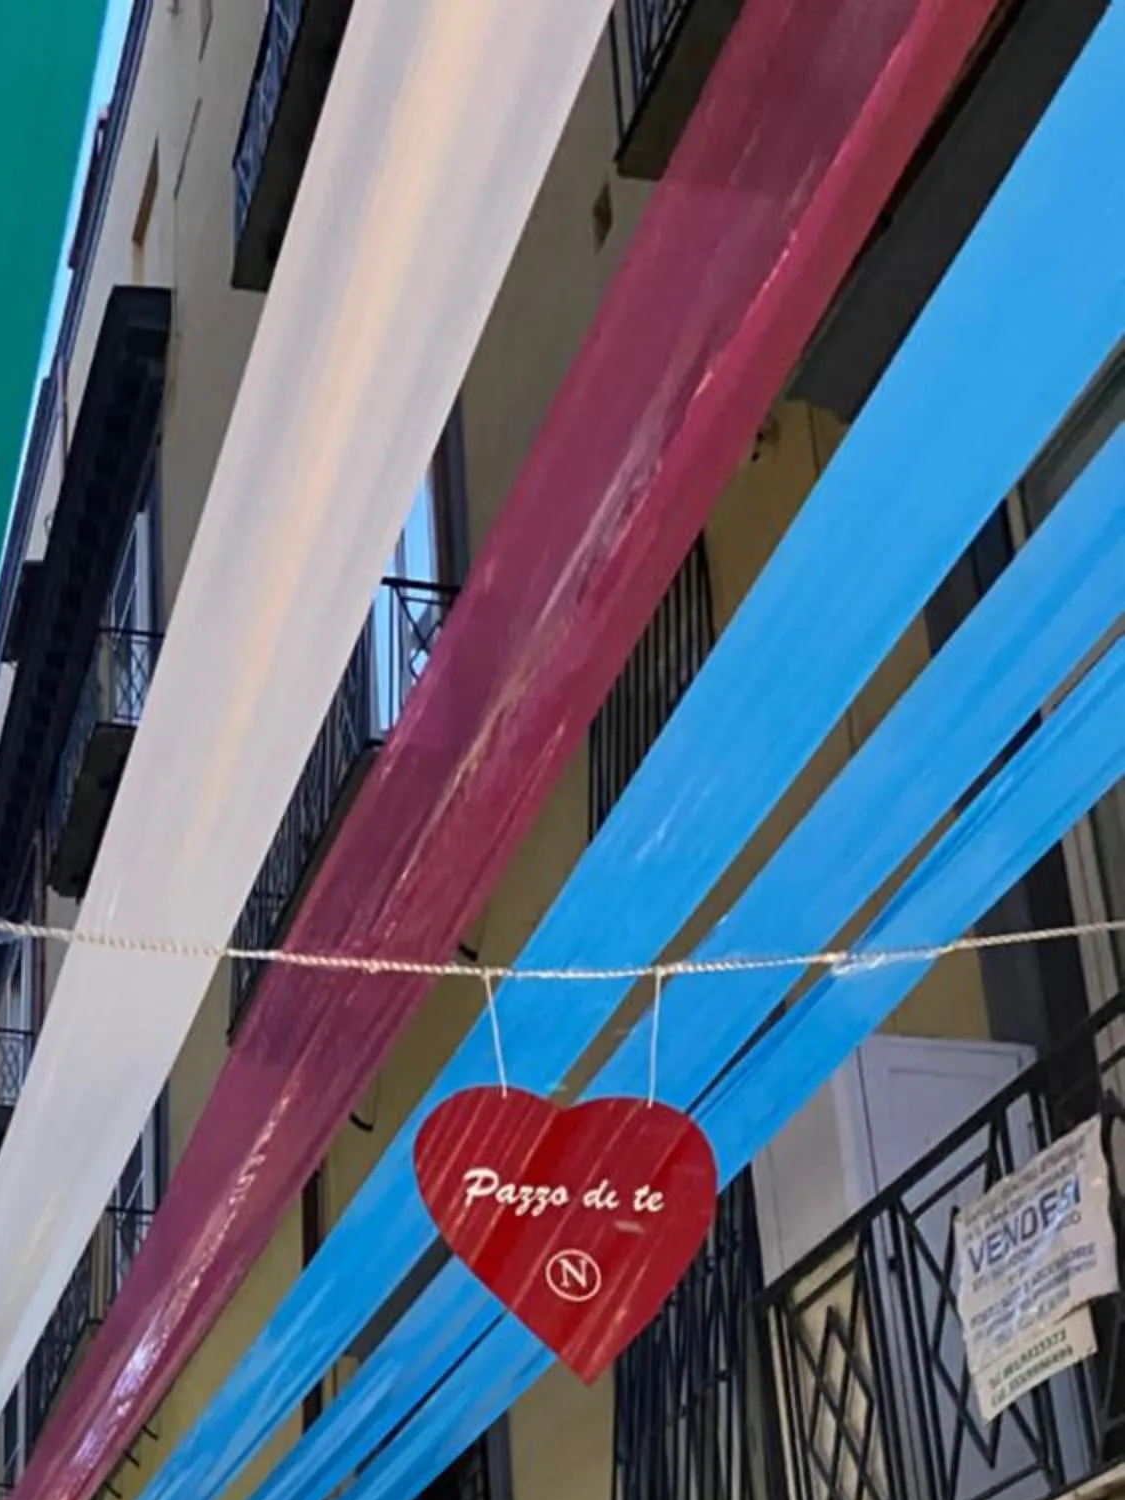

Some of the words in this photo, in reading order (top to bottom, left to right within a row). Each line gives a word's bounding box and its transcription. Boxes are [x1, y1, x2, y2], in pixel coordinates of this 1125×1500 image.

[463, 1167, 570, 1217] Pazzo
[582, 1179, 621, 1209] di
[633, 1184, 665, 1212] te
[967, 1176, 1081, 1273] VENDESI
